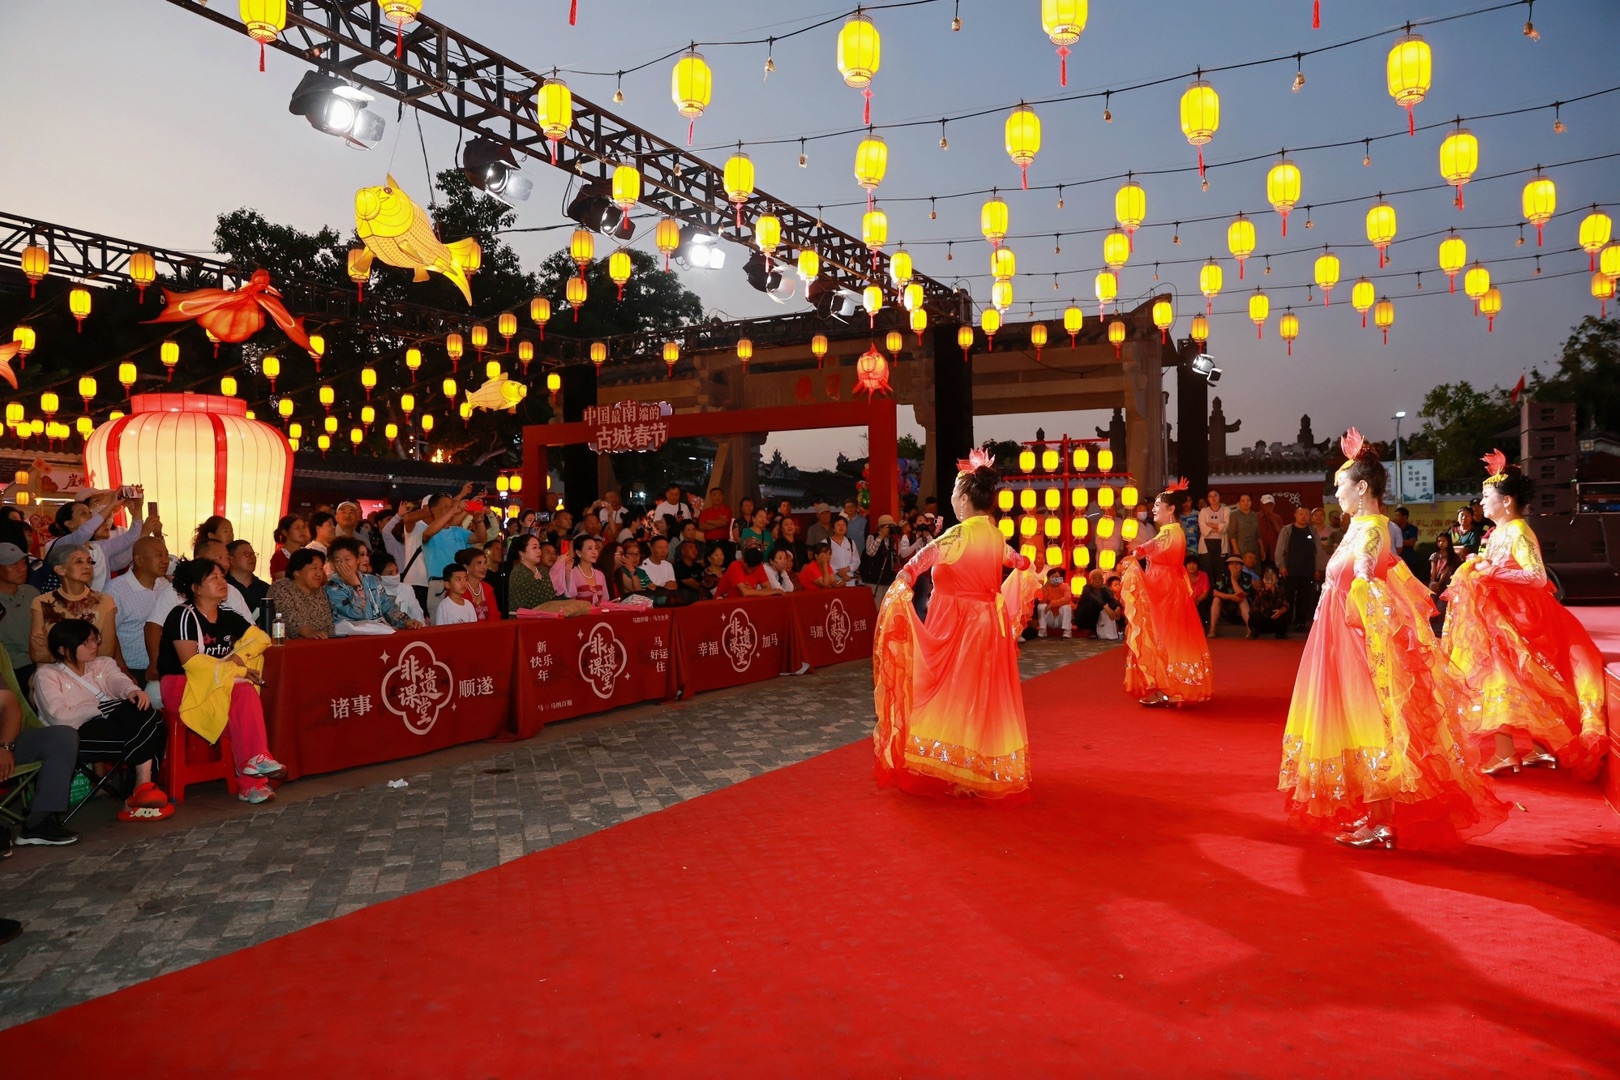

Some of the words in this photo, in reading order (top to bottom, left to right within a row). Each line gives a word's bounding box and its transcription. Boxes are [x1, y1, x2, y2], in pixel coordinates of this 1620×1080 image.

[583, 400, 660, 426] 中国最南端的
[596, 422, 667, 449] 古城春节
[537, 641, 547, 654] 新
[653, 636, 663, 647] 马
[698, 640, 719, 657] 幸福
[762, 633, 779, 649] 加马
[729, 617, 753, 666] 非遗课堂
[530, 655, 553, 669] 快乐
[588, 633, 618, 691] 非遗课堂
[650, 648, 669, 660] 好运
[537, 669, 549, 682] 年
[656, 661, 666, 673] 住
[330, 694, 373, 720] 诸事
[458, 675, 494, 699] 顺遂
[398, 654, 445, 726] 非遗课堂
